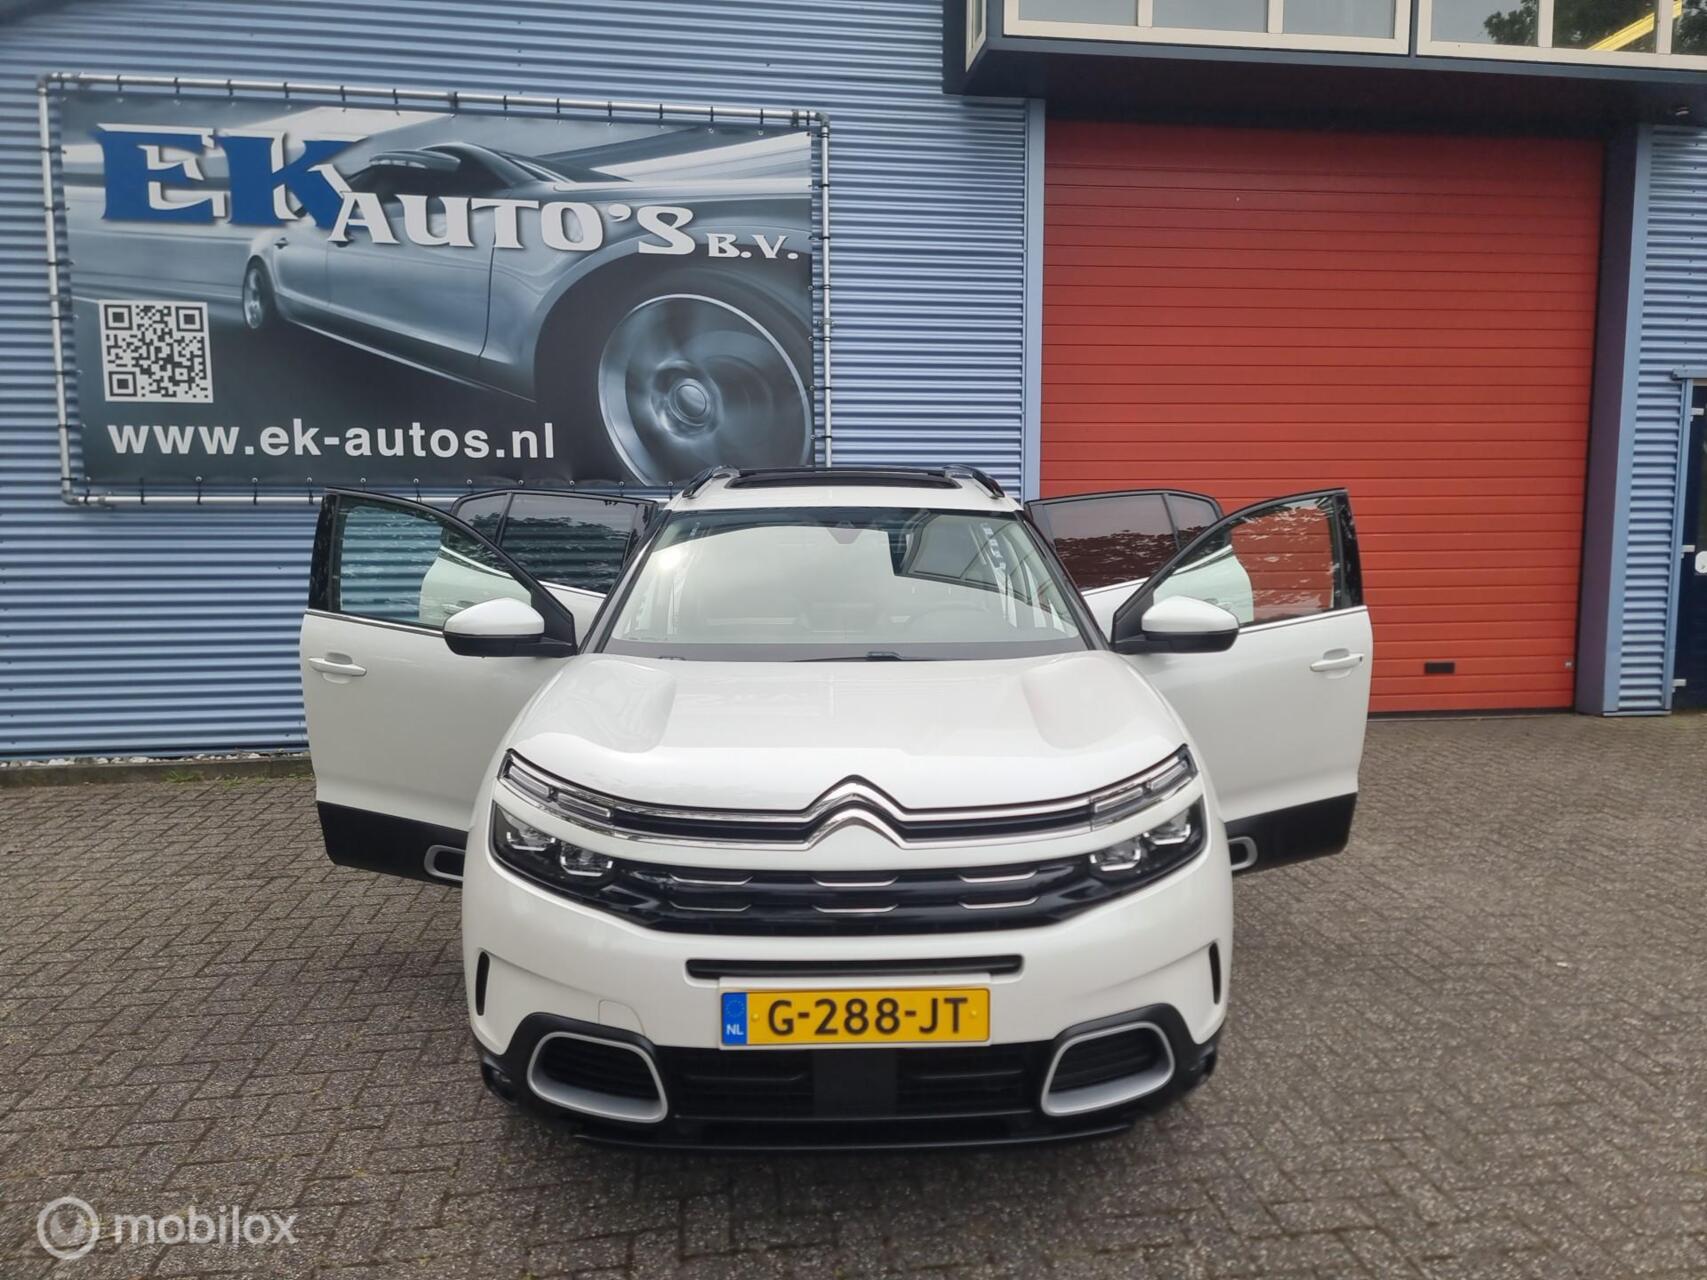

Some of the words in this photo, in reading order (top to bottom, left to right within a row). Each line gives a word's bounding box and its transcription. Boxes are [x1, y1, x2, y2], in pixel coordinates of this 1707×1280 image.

[97, 123, 369, 230] EK
[328, 190, 697, 256] AUTO'S
[706, 232, 800, 260] B.V.
[107, 419, 555, 459] www.ek-autos.nl
[726, 1023, 744, 1036] NL
[768, 997, 968, 1036] G-288-JT
